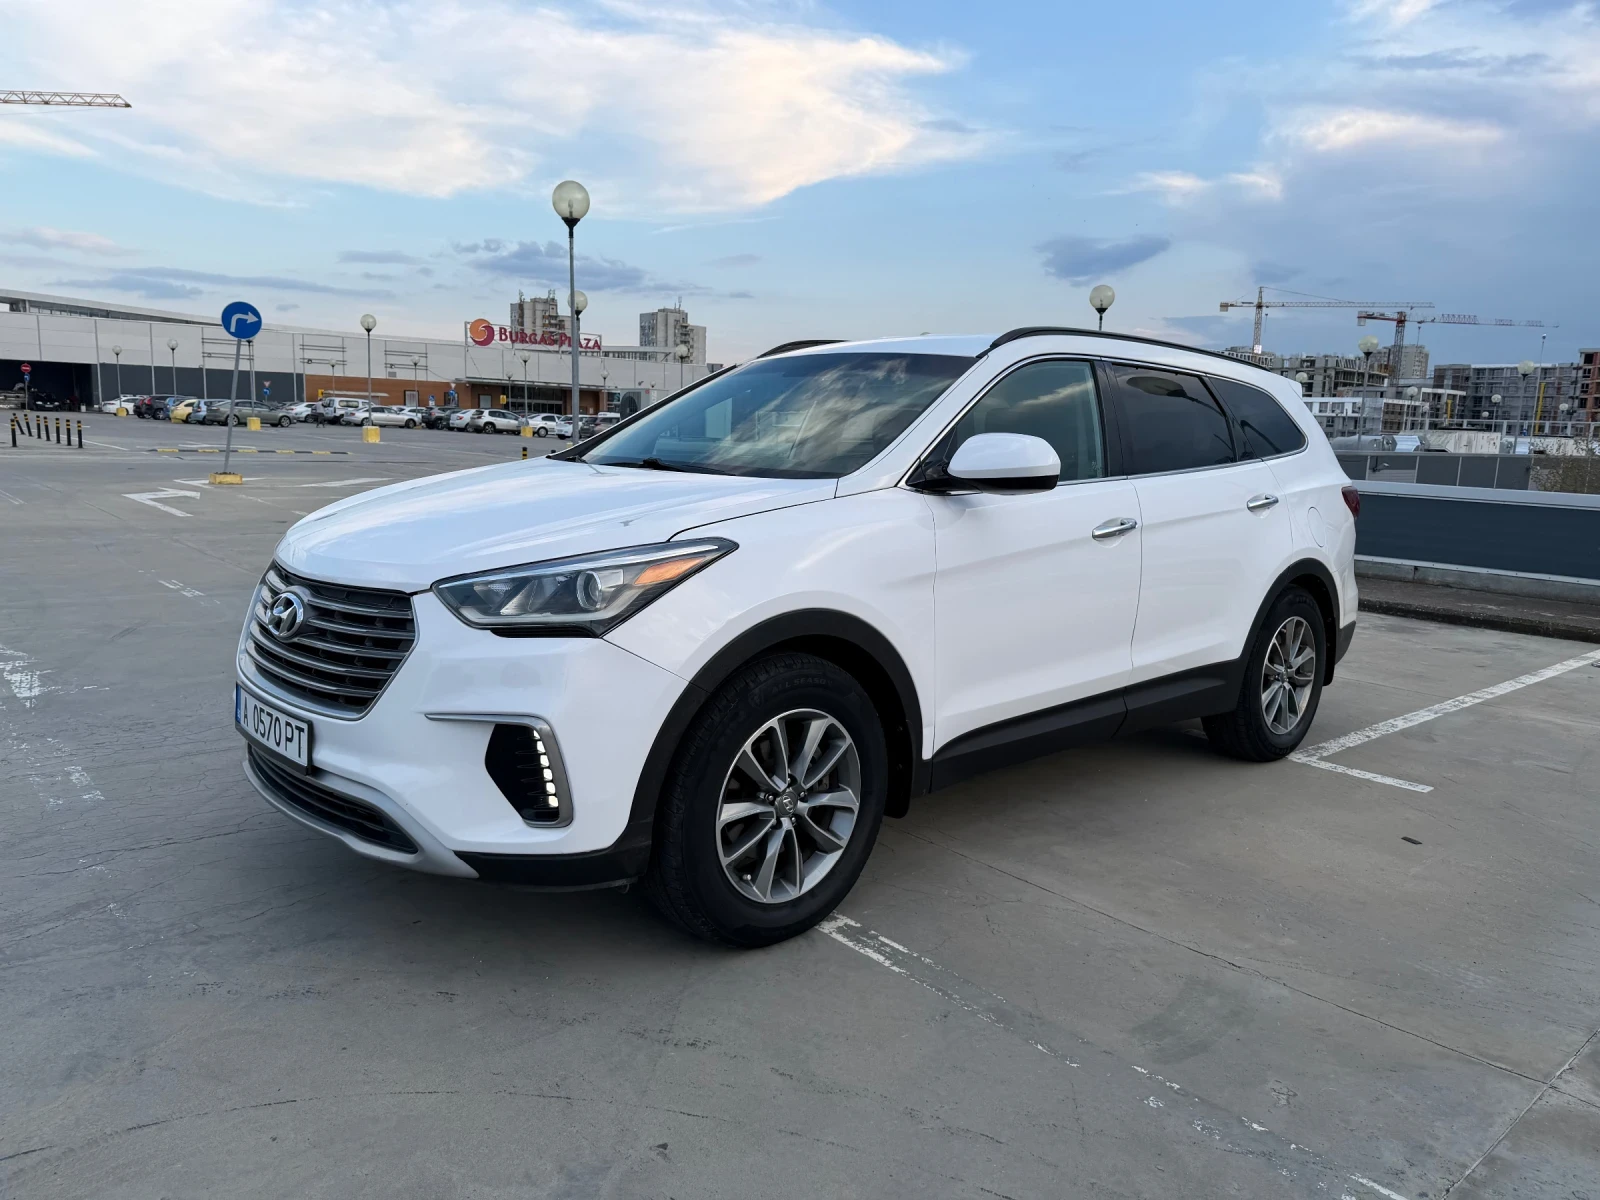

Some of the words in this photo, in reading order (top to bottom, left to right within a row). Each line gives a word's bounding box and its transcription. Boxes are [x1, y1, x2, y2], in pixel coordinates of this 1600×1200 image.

[499, 327, 555, 346] BURGAS
[243, 696, 249, 727] A
[253, 704, 281, 747] 0570
[285, 720, 305, 758] PT
